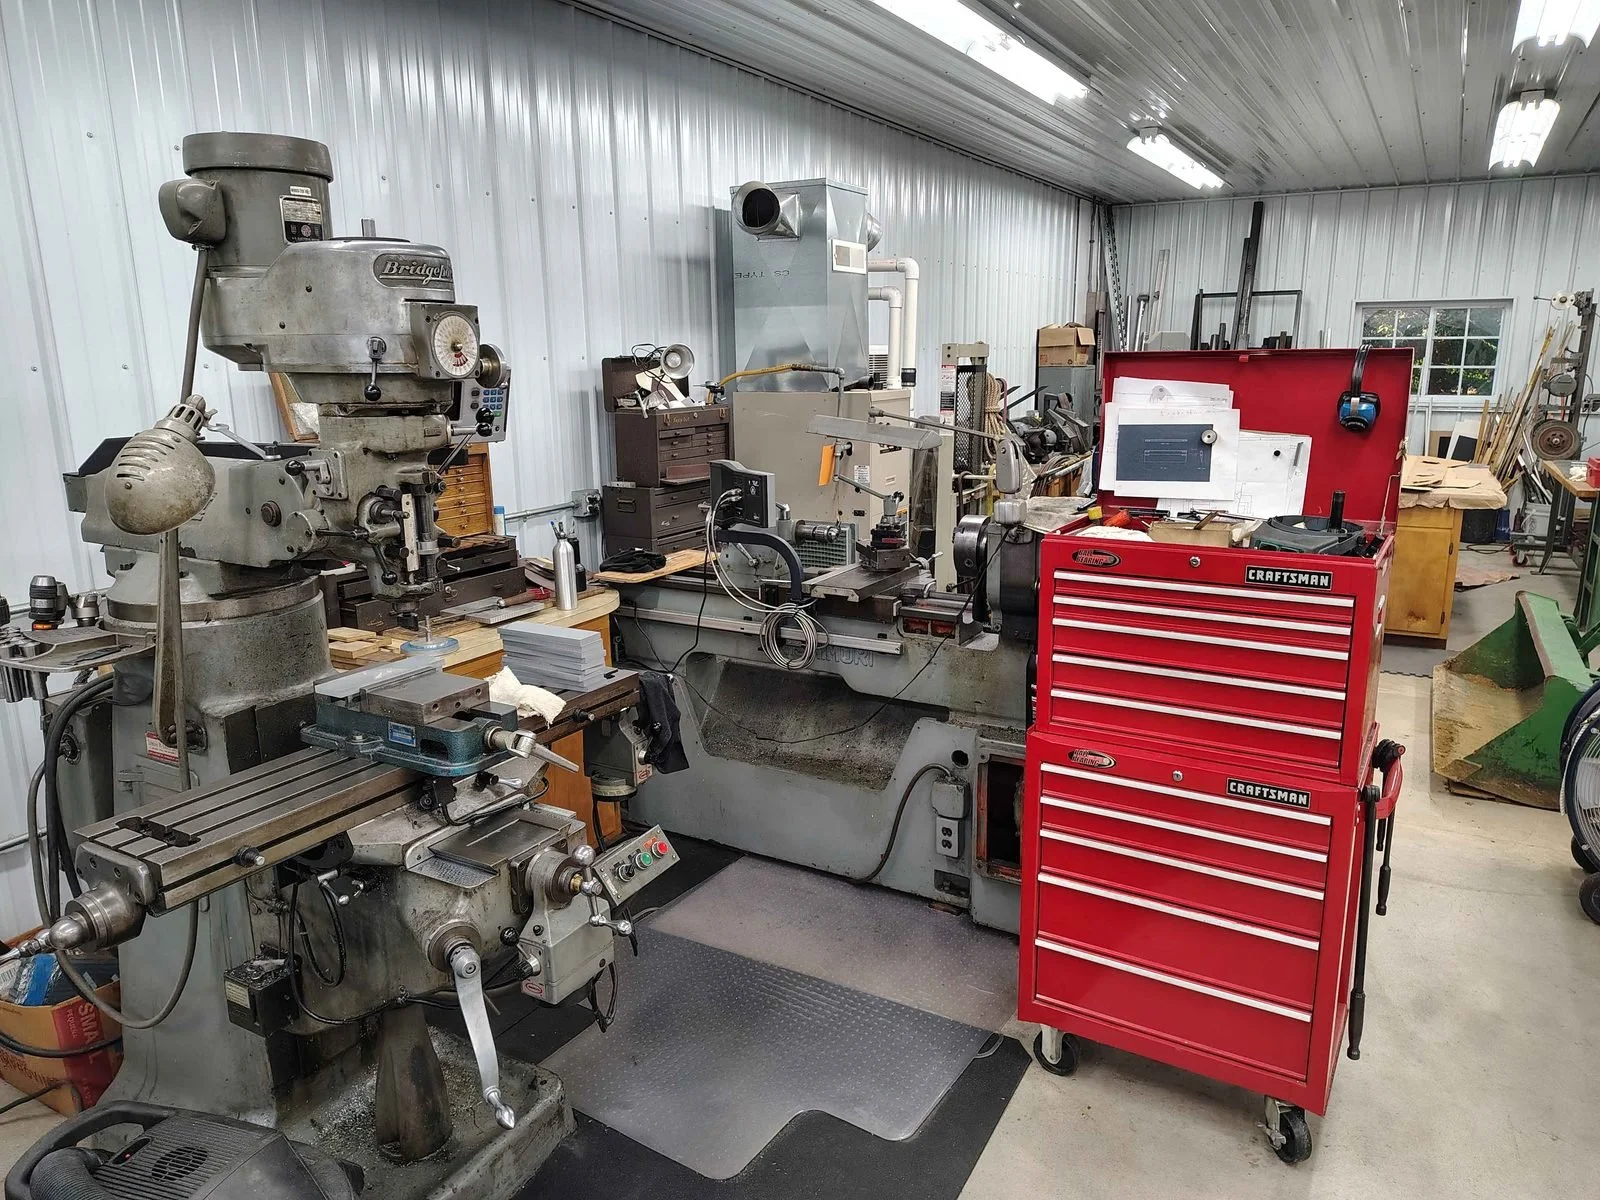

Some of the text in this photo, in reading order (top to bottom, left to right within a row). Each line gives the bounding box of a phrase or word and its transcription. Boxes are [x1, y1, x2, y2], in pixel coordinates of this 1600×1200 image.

[735, 271, 765, 279] TYPE
[1248, 569, 1330, 587] CRAFTSMAN
[1229, 781, 1308, 805] CRAFTSMAN
[78, 1002, 100, 1065] SMAL
